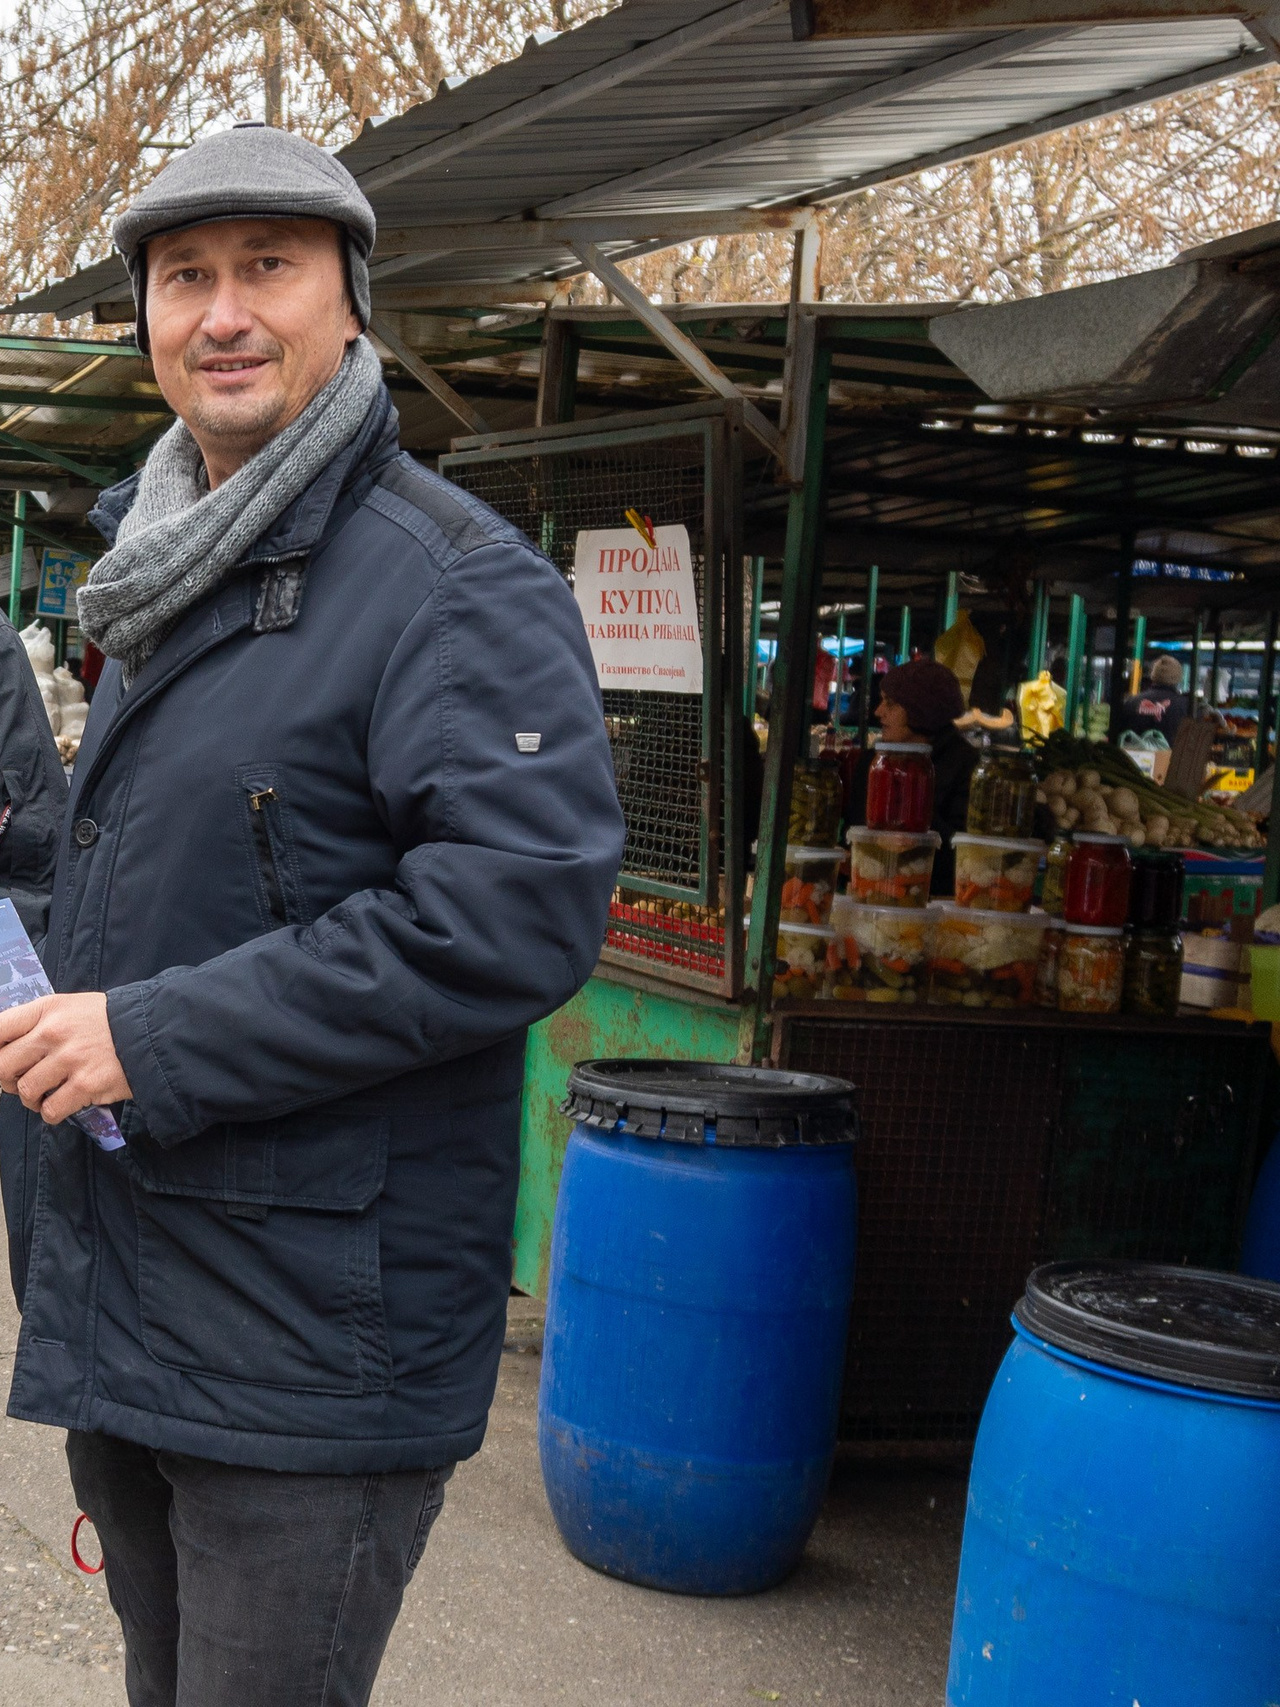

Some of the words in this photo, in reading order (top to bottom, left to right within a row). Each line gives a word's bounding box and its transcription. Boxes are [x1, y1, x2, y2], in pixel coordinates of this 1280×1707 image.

[598, 547, 681, 578] ПРОДАЈА
[600, 589, 682, 615] КУПУСА
[584, 624, 649, 641] ЛАВИЦА
[653, 624, 696, 643] РИБАНАЦ
